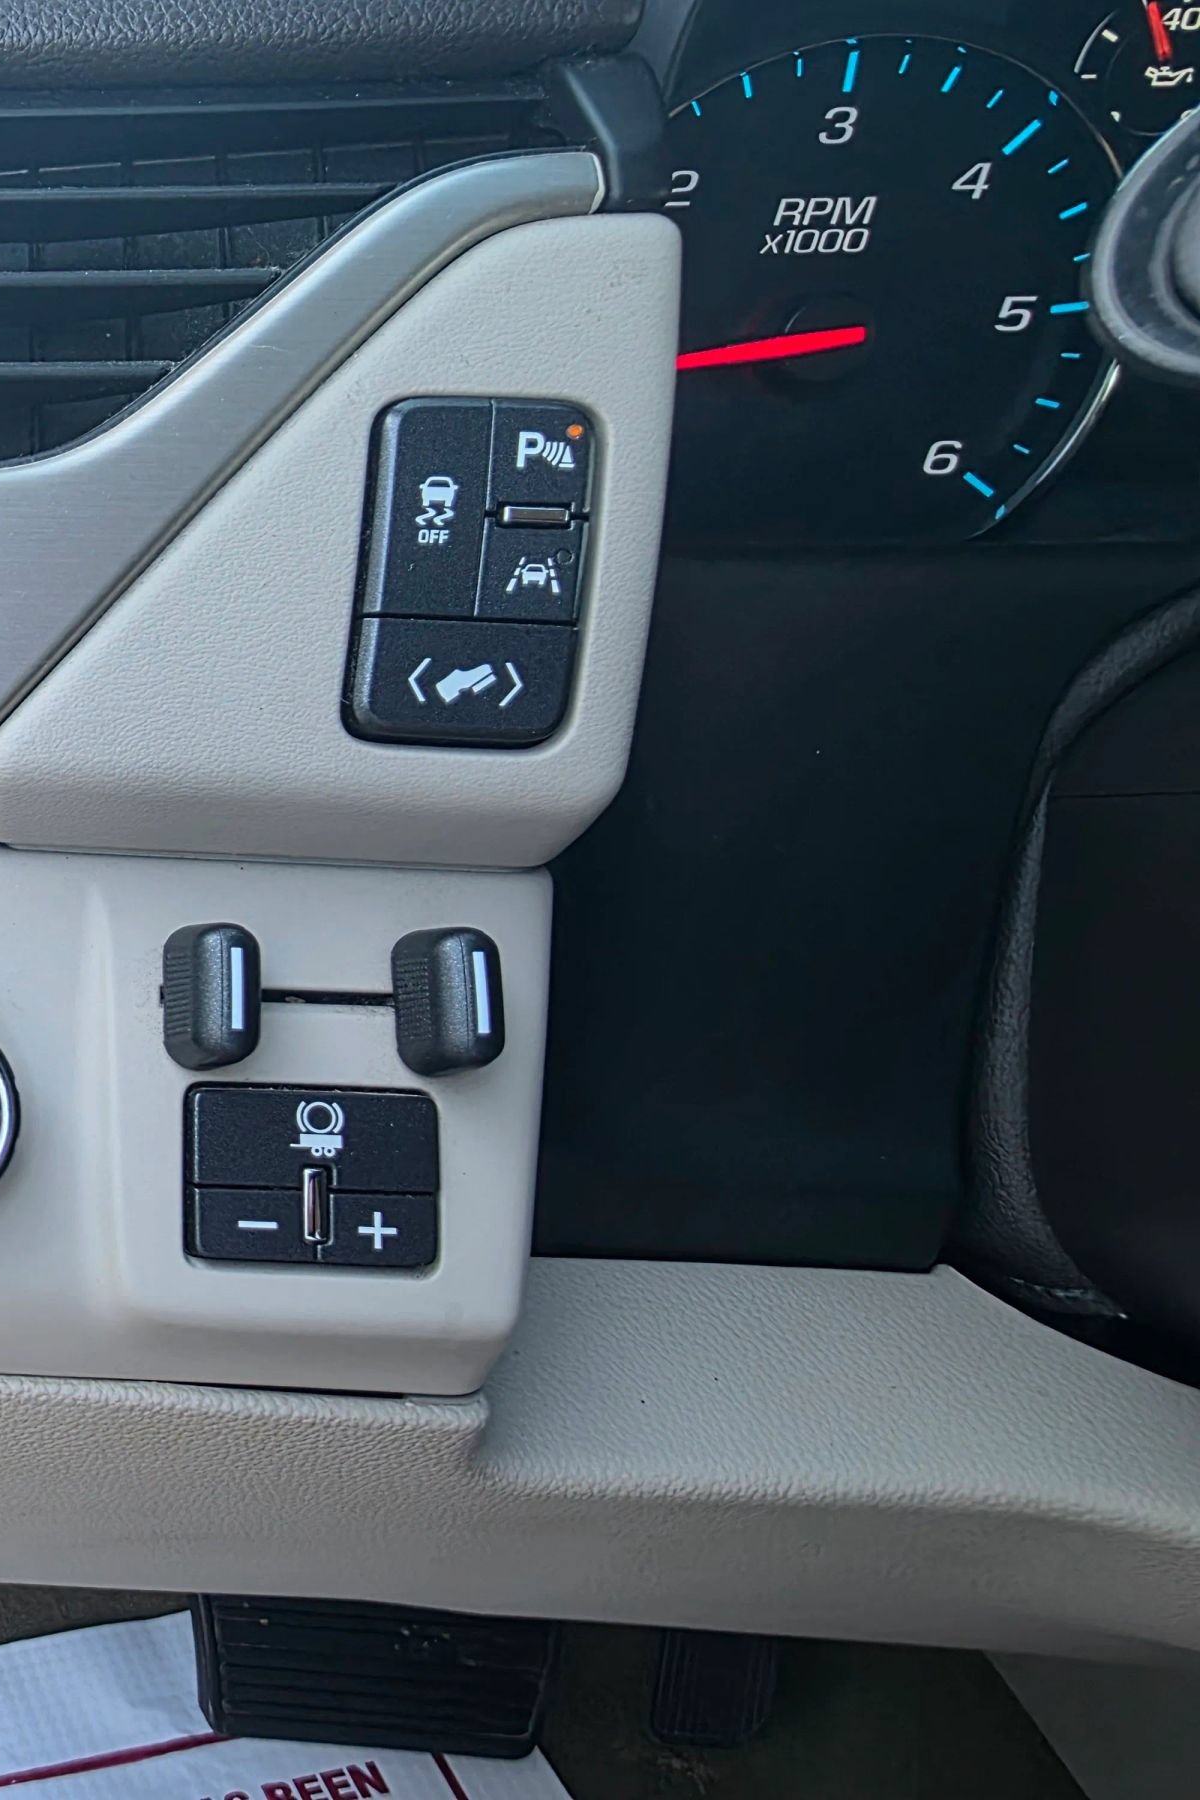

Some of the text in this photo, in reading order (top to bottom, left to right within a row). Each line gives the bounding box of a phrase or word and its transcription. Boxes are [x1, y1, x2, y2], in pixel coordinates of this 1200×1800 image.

[1161, 7, 1200, 31] 40
[818, 106, 858, 144] 3
[664, 169, 700, 208] 2
[952, 162, 992, 200] 4
[773, 195, 878, 227] RPM
[759, 228, 870, 255] x1000
[994, 295, 1039, 332] 5
[922, 440, 963, 475] 6
[417, 529, 450, 546] OFF
